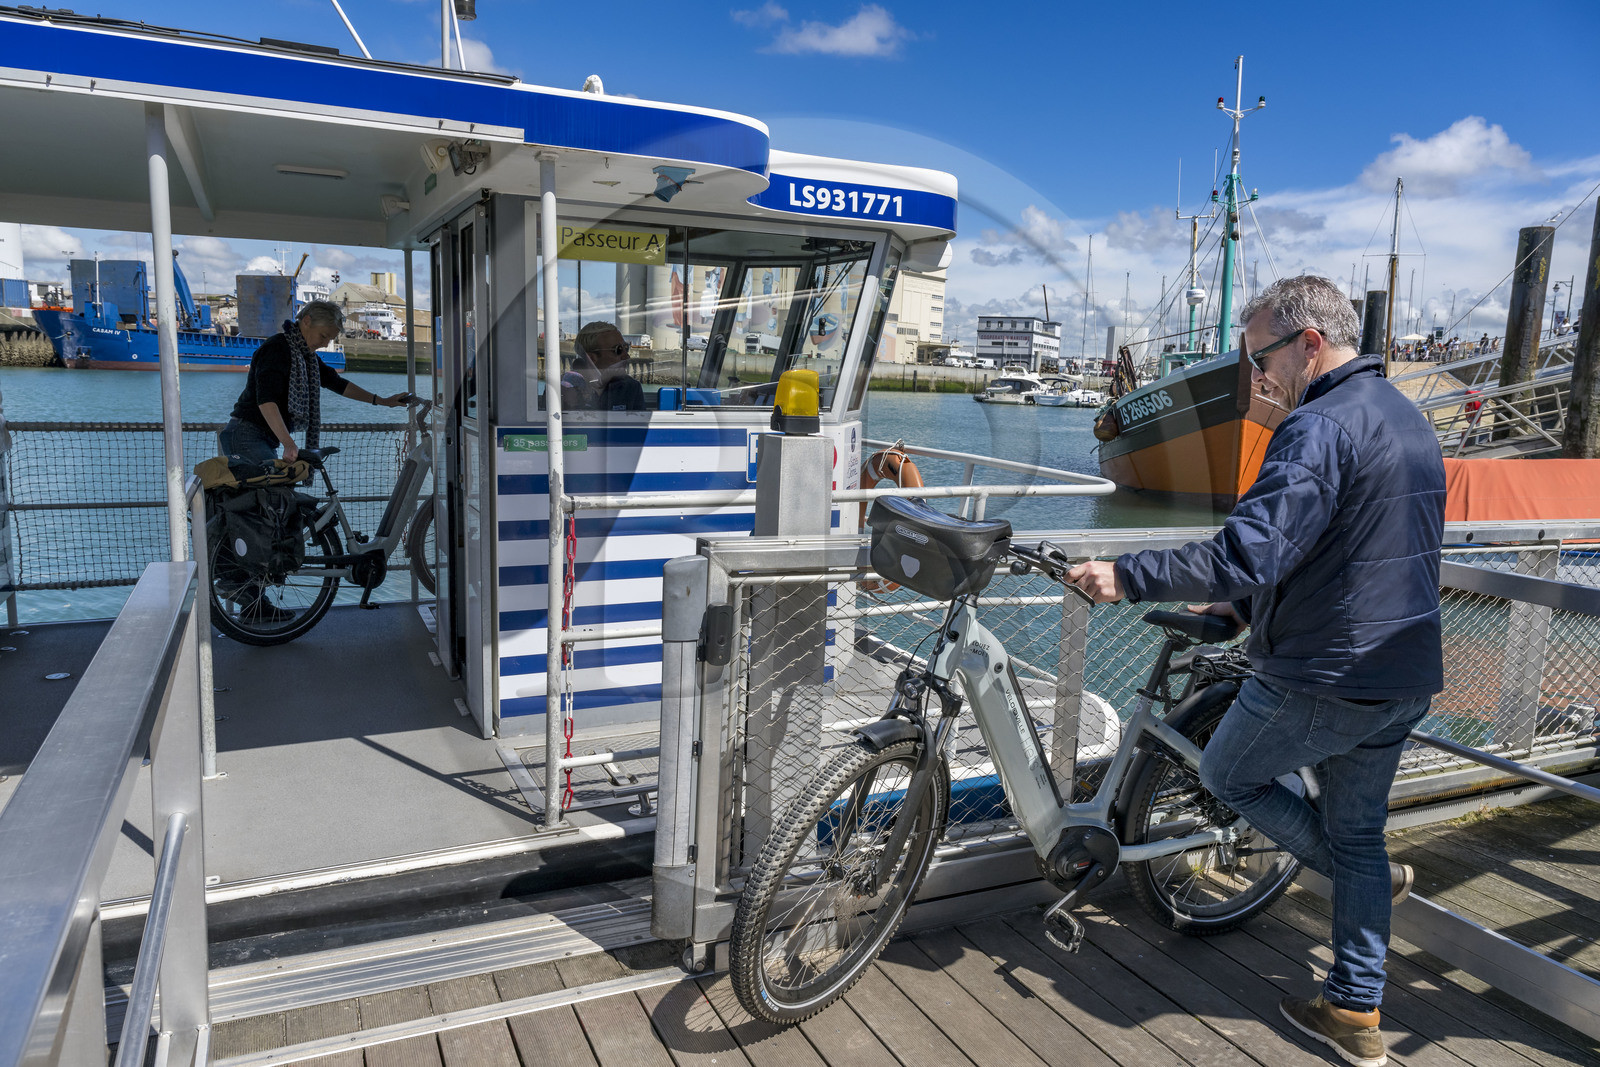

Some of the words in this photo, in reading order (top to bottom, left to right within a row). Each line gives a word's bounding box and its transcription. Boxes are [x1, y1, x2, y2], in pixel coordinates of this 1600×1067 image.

[789, 182, 903, 217] LS931771
[561, 226, 640, 250] Passeur
[644, 234, 661, 252] A
[1120, 406, 1131, 426] LS
[1127, 389, 1174, 421] 266506
[513, 438, 526, 447] 35
[528, 439, 578, 449] pasers
